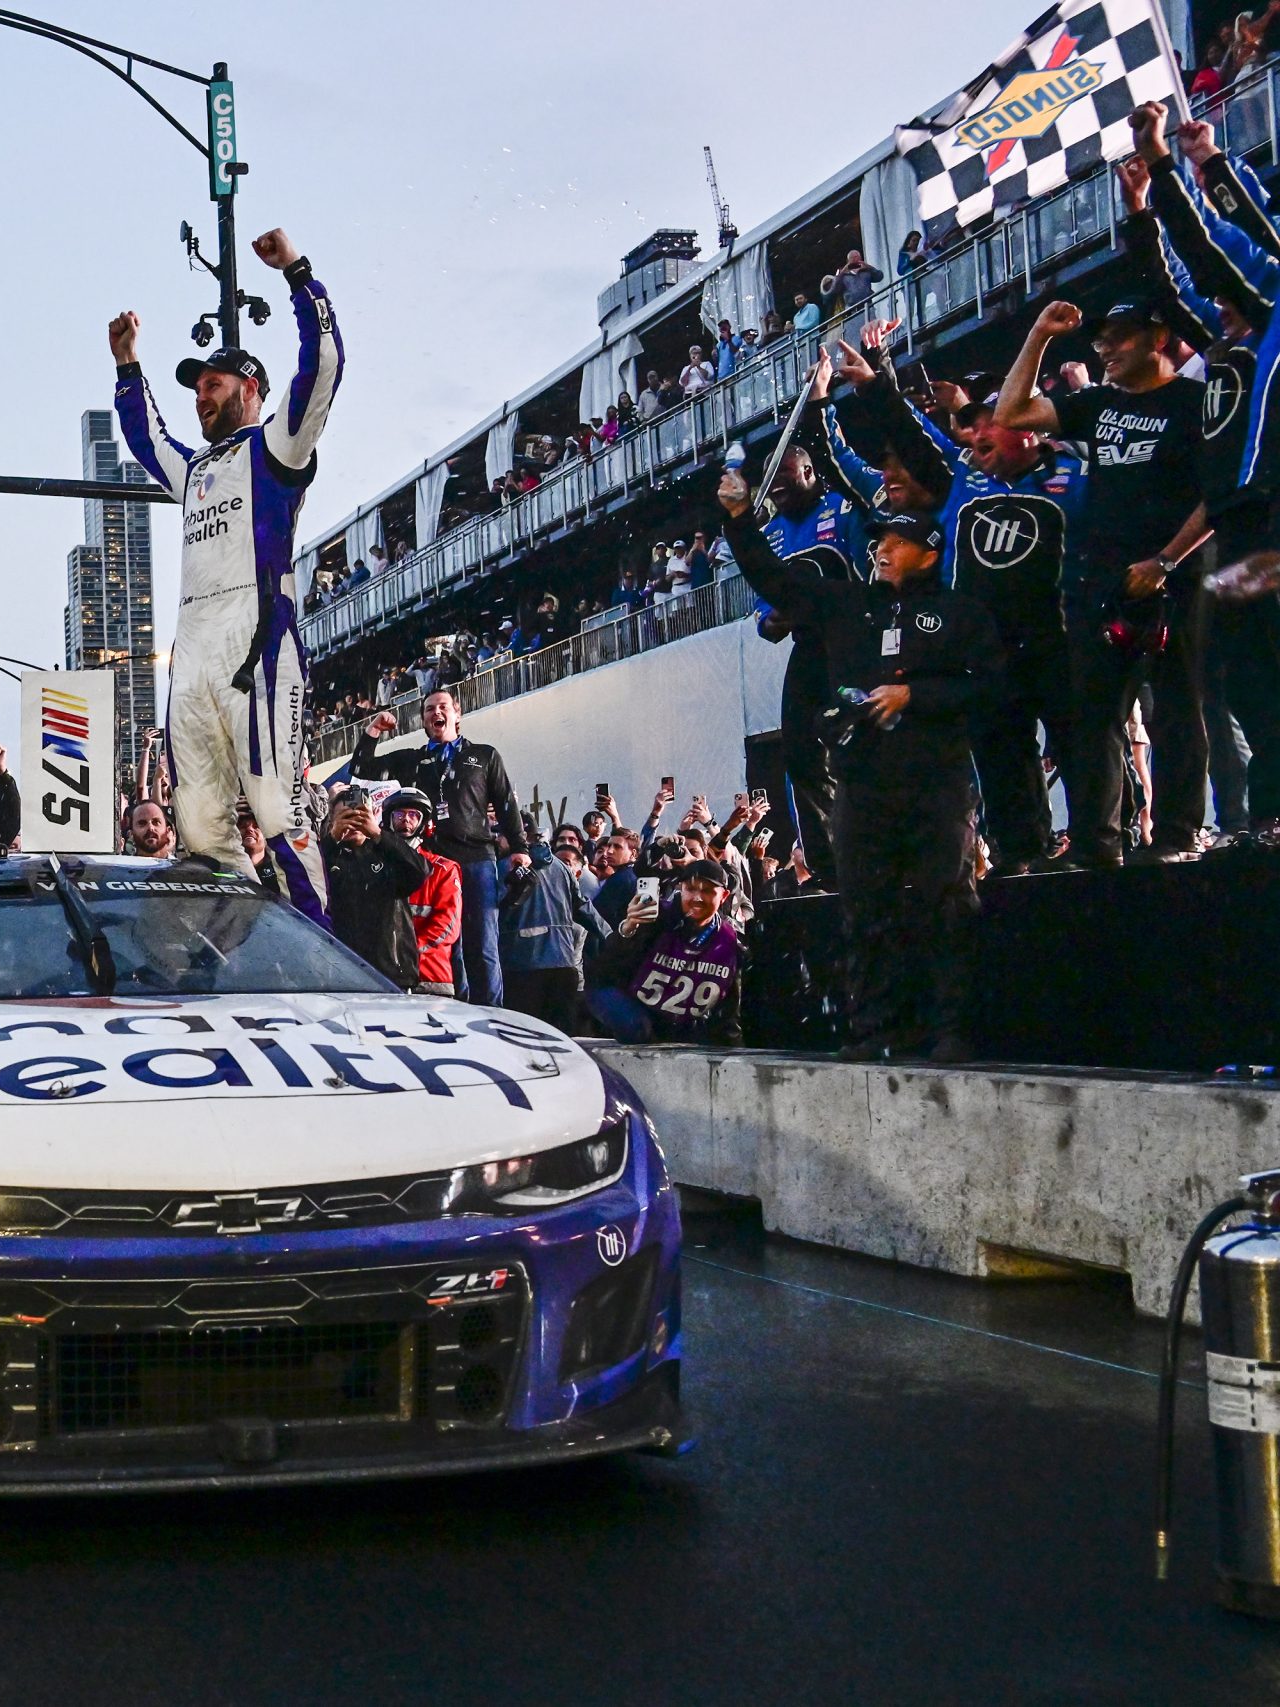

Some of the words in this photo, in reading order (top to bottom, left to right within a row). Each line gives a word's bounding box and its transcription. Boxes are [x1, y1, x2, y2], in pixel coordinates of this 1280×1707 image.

[241, 362, 256, 376] 91
[1096, 439, 1160, 466] SVG
[288, 685, 299, 745] health
[41, 758, 90, 832] 75
[36, 881, 100, 891] VN
[105, 881, 258, 895] GISBERGEN
[697, 961, 730, 979] VIDEO
[636, 970, 721, 1018] 529
[429, 1268, 508, 1297] ZL1
